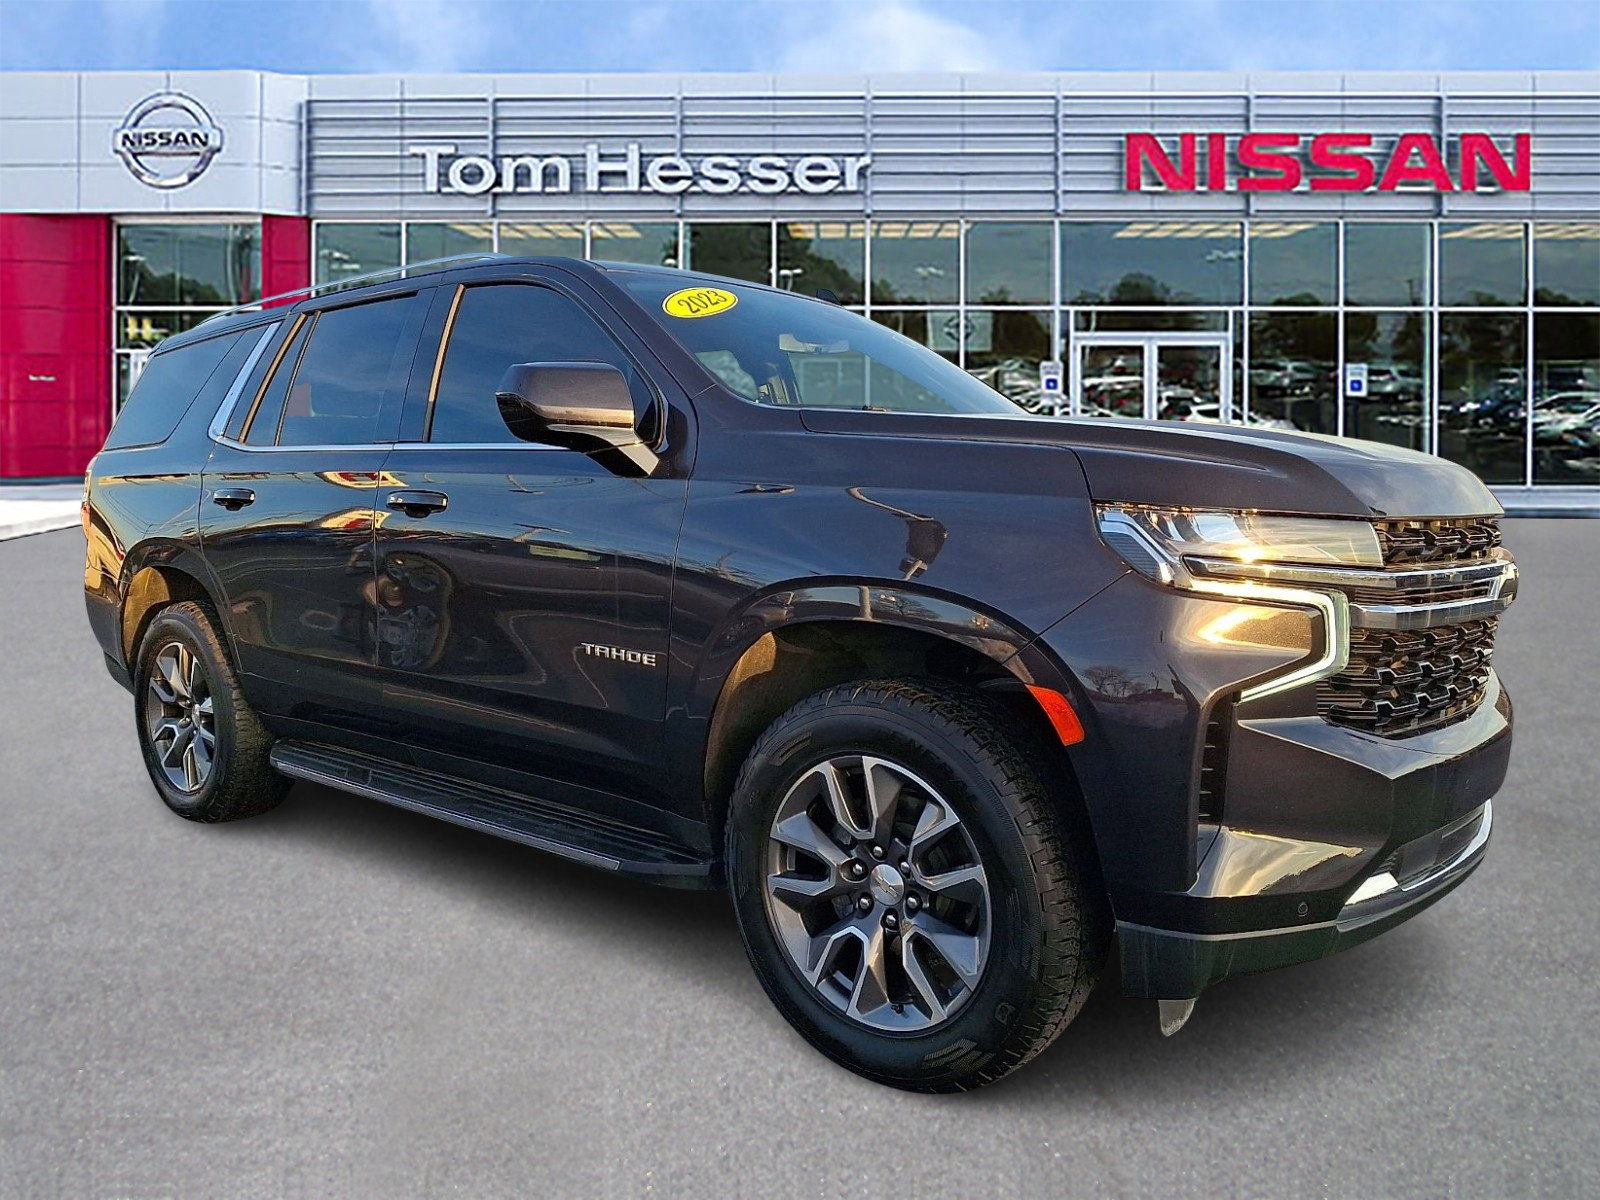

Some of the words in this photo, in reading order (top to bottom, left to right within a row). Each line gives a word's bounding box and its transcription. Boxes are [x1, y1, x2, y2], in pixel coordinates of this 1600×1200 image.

[121, 131, 209, 147] NISSAN
[408, 145, 571, 194] Tom
[584, 143, 872, 194] Hesser
[1125, 132, 1531, 192] NISSAN
[677, 290, 727, 313] 2023
[580, 642, 656, 667] TAHOE
